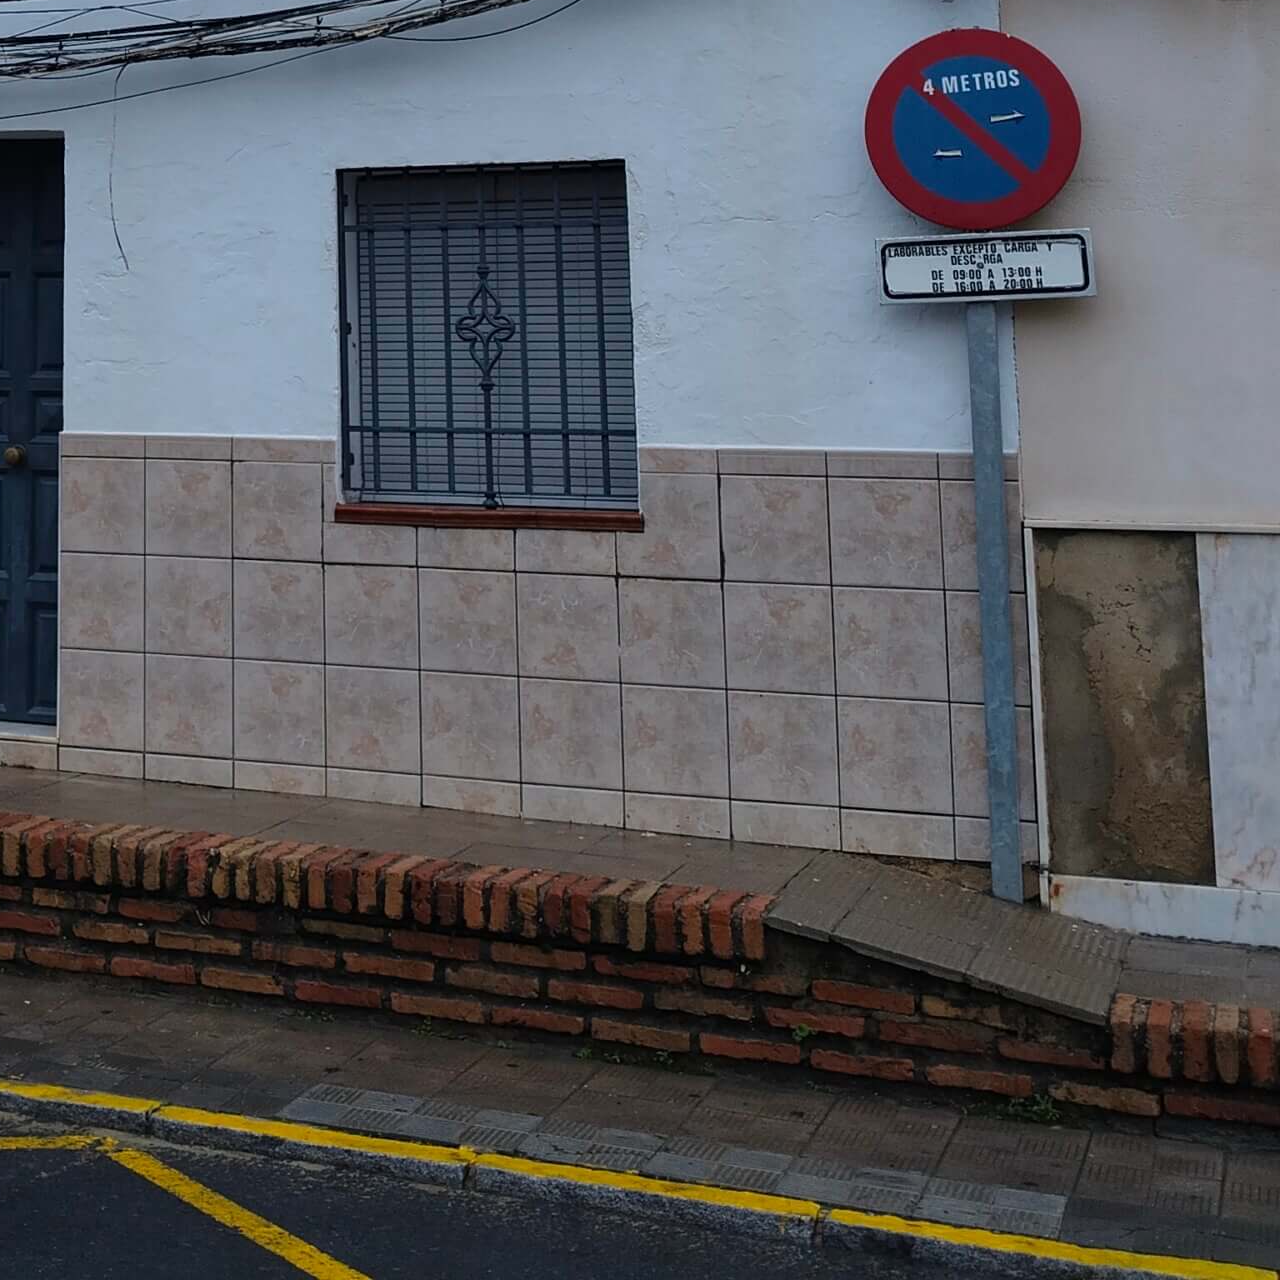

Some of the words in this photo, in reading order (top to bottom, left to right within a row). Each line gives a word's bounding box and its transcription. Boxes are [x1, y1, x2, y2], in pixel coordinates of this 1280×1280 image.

[922, 78, 935, 96] 4
[941, 68, 1020, 95] METROS
[888, 245, 948, 258] LABORABLES
[953, 242, 997, 256] EXCEPTO
[1004, 241, 1038, 253] CARGA
[1046, 241, 1053, 252] Y
[951, 253, 1003, 266] DESCRGA
[931, 269, 944, 281] DE
[952, 268, 982, 281] 09:00
[987, 268, 994, 279] A
[1002, 266, 1031, 278] 13:00
[1035, 265, 1043, 277] H
[931, 281, 945, 293] DE
[954, 280, 983, 292] 16:00
[989, 280, 996, 291] A
[1003, 278, 1033, 290] 20:00
[1036, 277, 1043, 289] H
